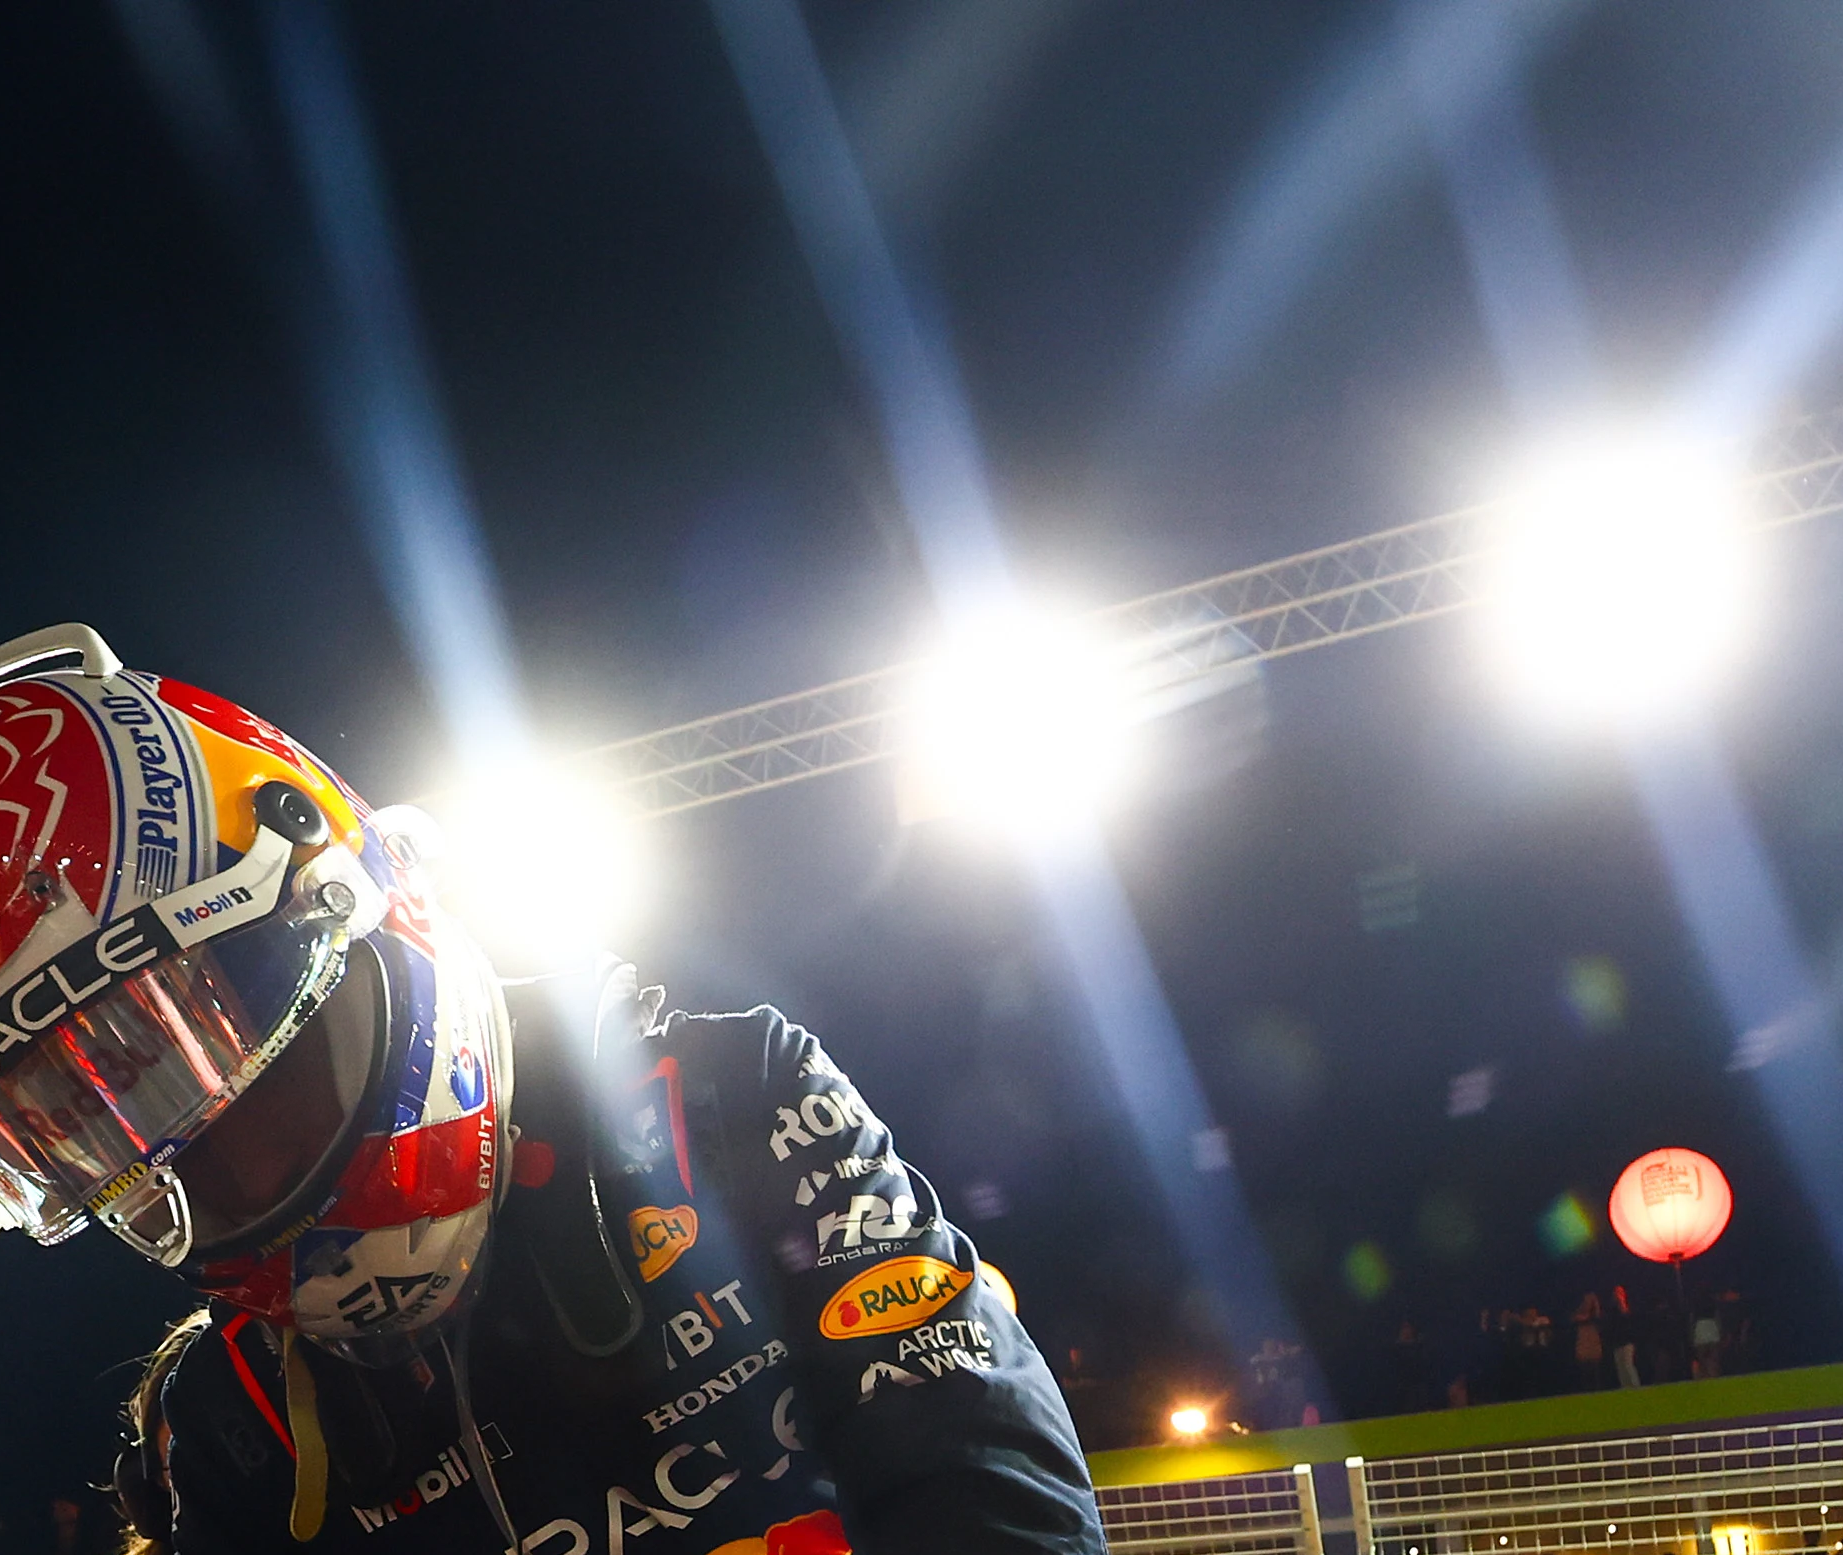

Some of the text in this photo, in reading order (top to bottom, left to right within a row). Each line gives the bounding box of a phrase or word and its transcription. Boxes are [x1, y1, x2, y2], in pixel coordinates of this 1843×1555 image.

[137, 727, 184, 853] Player
[173, 892, 232, 928] Mobil
[477, 1113, 494, 1191] BYBIT
[635, 1218, 688, 1262] UCH
[859, 1274, 958, 1318] RAUCH
[663, 1280, 754, 1371] BIT
[897, 1319, 994, 1362] ARCTIC
[918, 1348, 992, 1378] WOLF
[642, 1338, 789, 1434] HONDA
